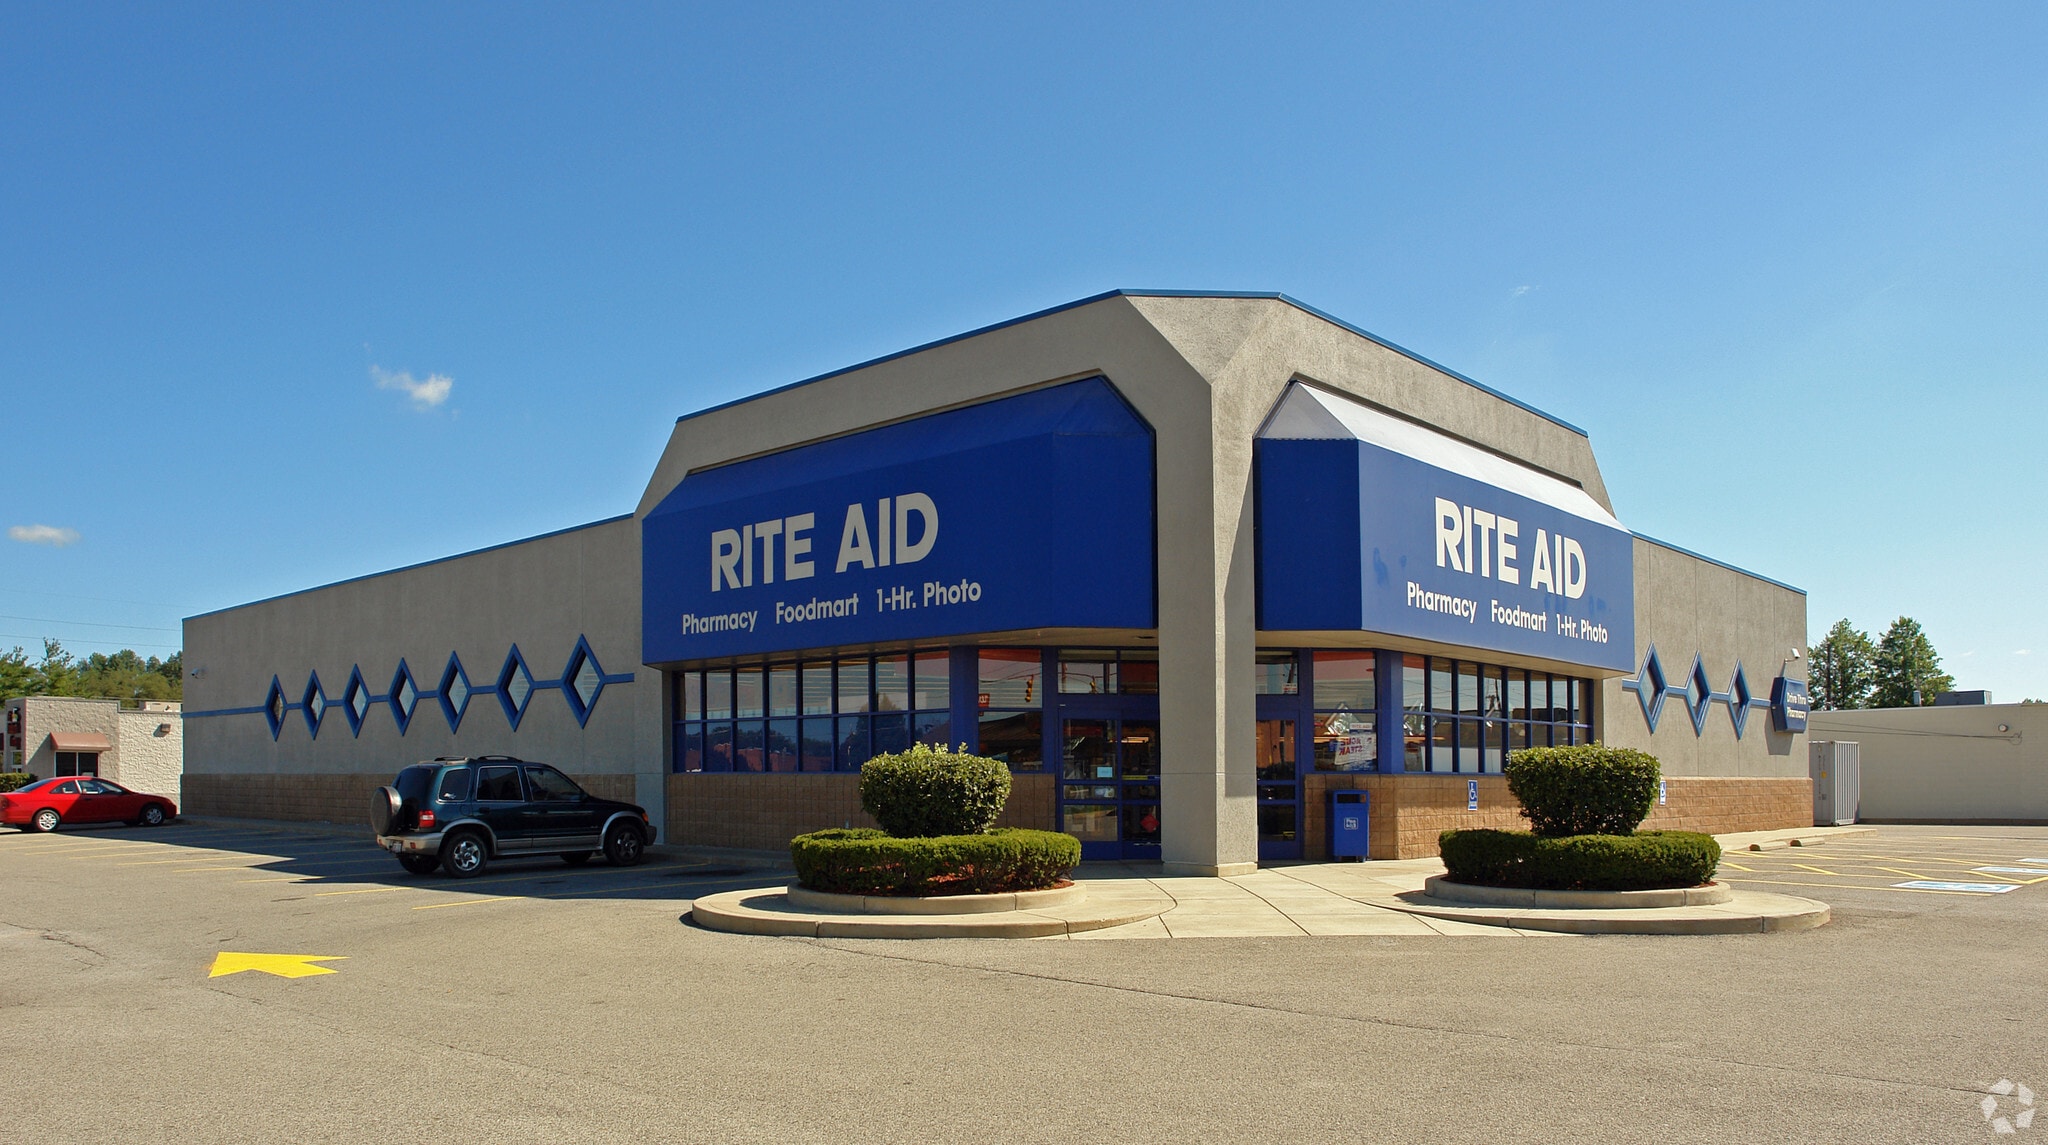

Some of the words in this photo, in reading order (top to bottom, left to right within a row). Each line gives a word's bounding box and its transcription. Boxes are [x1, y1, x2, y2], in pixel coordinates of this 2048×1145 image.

[711, 512, 815, 592] RITE
[835, 492, 939, 574] AID
[1435, 496, 1520, 585] RITE
[1530, 528, 1588, 600] AID
[682, 610, 758, 636] Pharmacy
[775, 592, 859, 625] Foodmart
[876, 585, 917, 613] 1-Hr.
[923, 578, 983, 608] Photo
[1406, 581, 1478, 624] Pharmacy
[1490, 599, 1548, 633] Foodmart
[1555, 613, 1579, 639] 1-Hr.
[1580, 619, 1609, 645] Photo
[1786, 692, 1797, 703] Drive
[1797, 693, 1806, 705] Thru
[1786, 706, 1806, 721] Pharmacy
